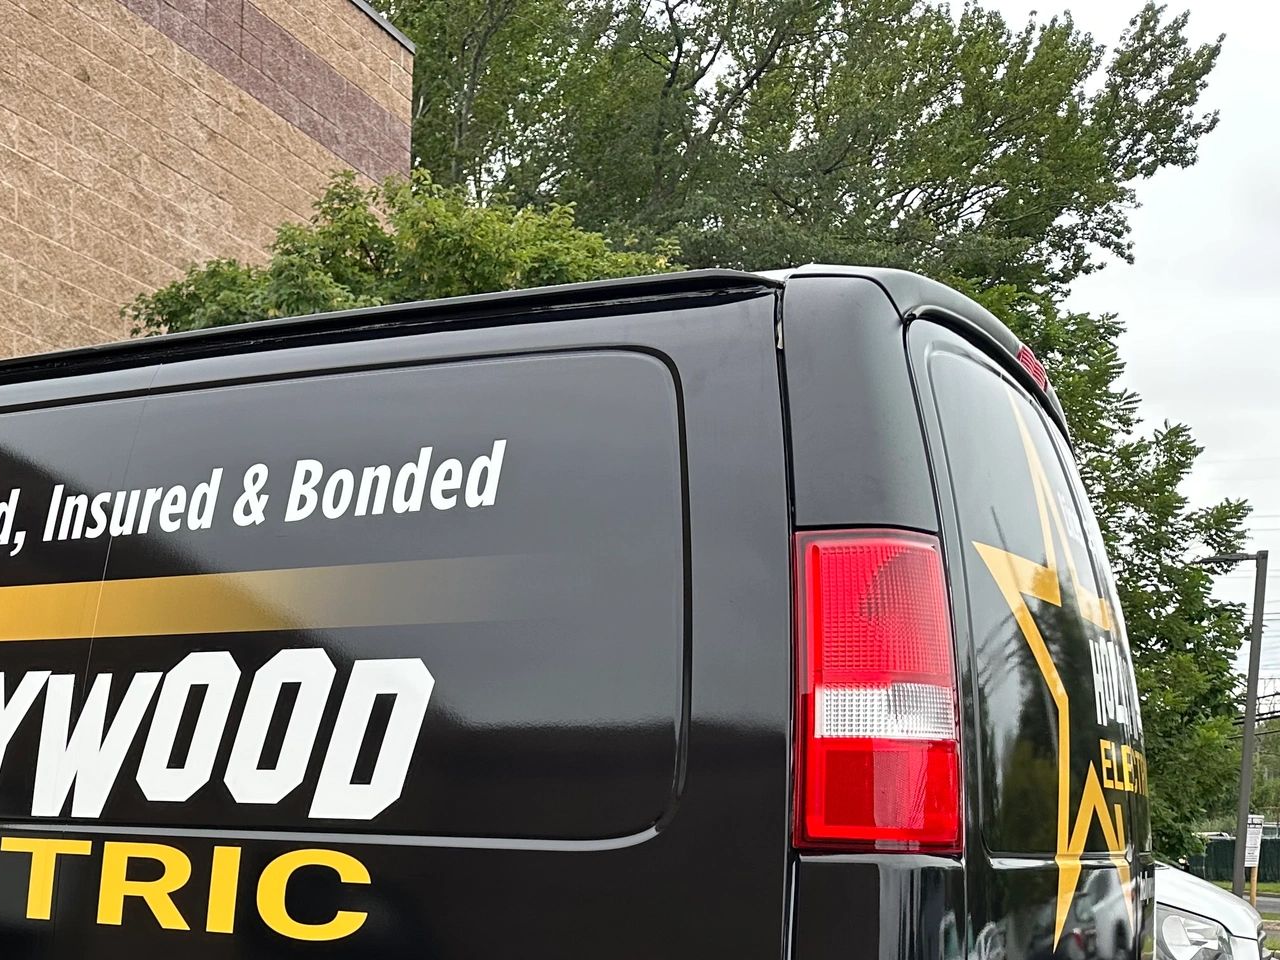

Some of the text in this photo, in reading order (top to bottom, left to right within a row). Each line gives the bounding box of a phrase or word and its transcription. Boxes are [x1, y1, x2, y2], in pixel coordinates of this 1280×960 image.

[41, 466, 224, 543] Insured
[231, 462, 268, 527] &
[284, 440, 507, 521] Bonded
